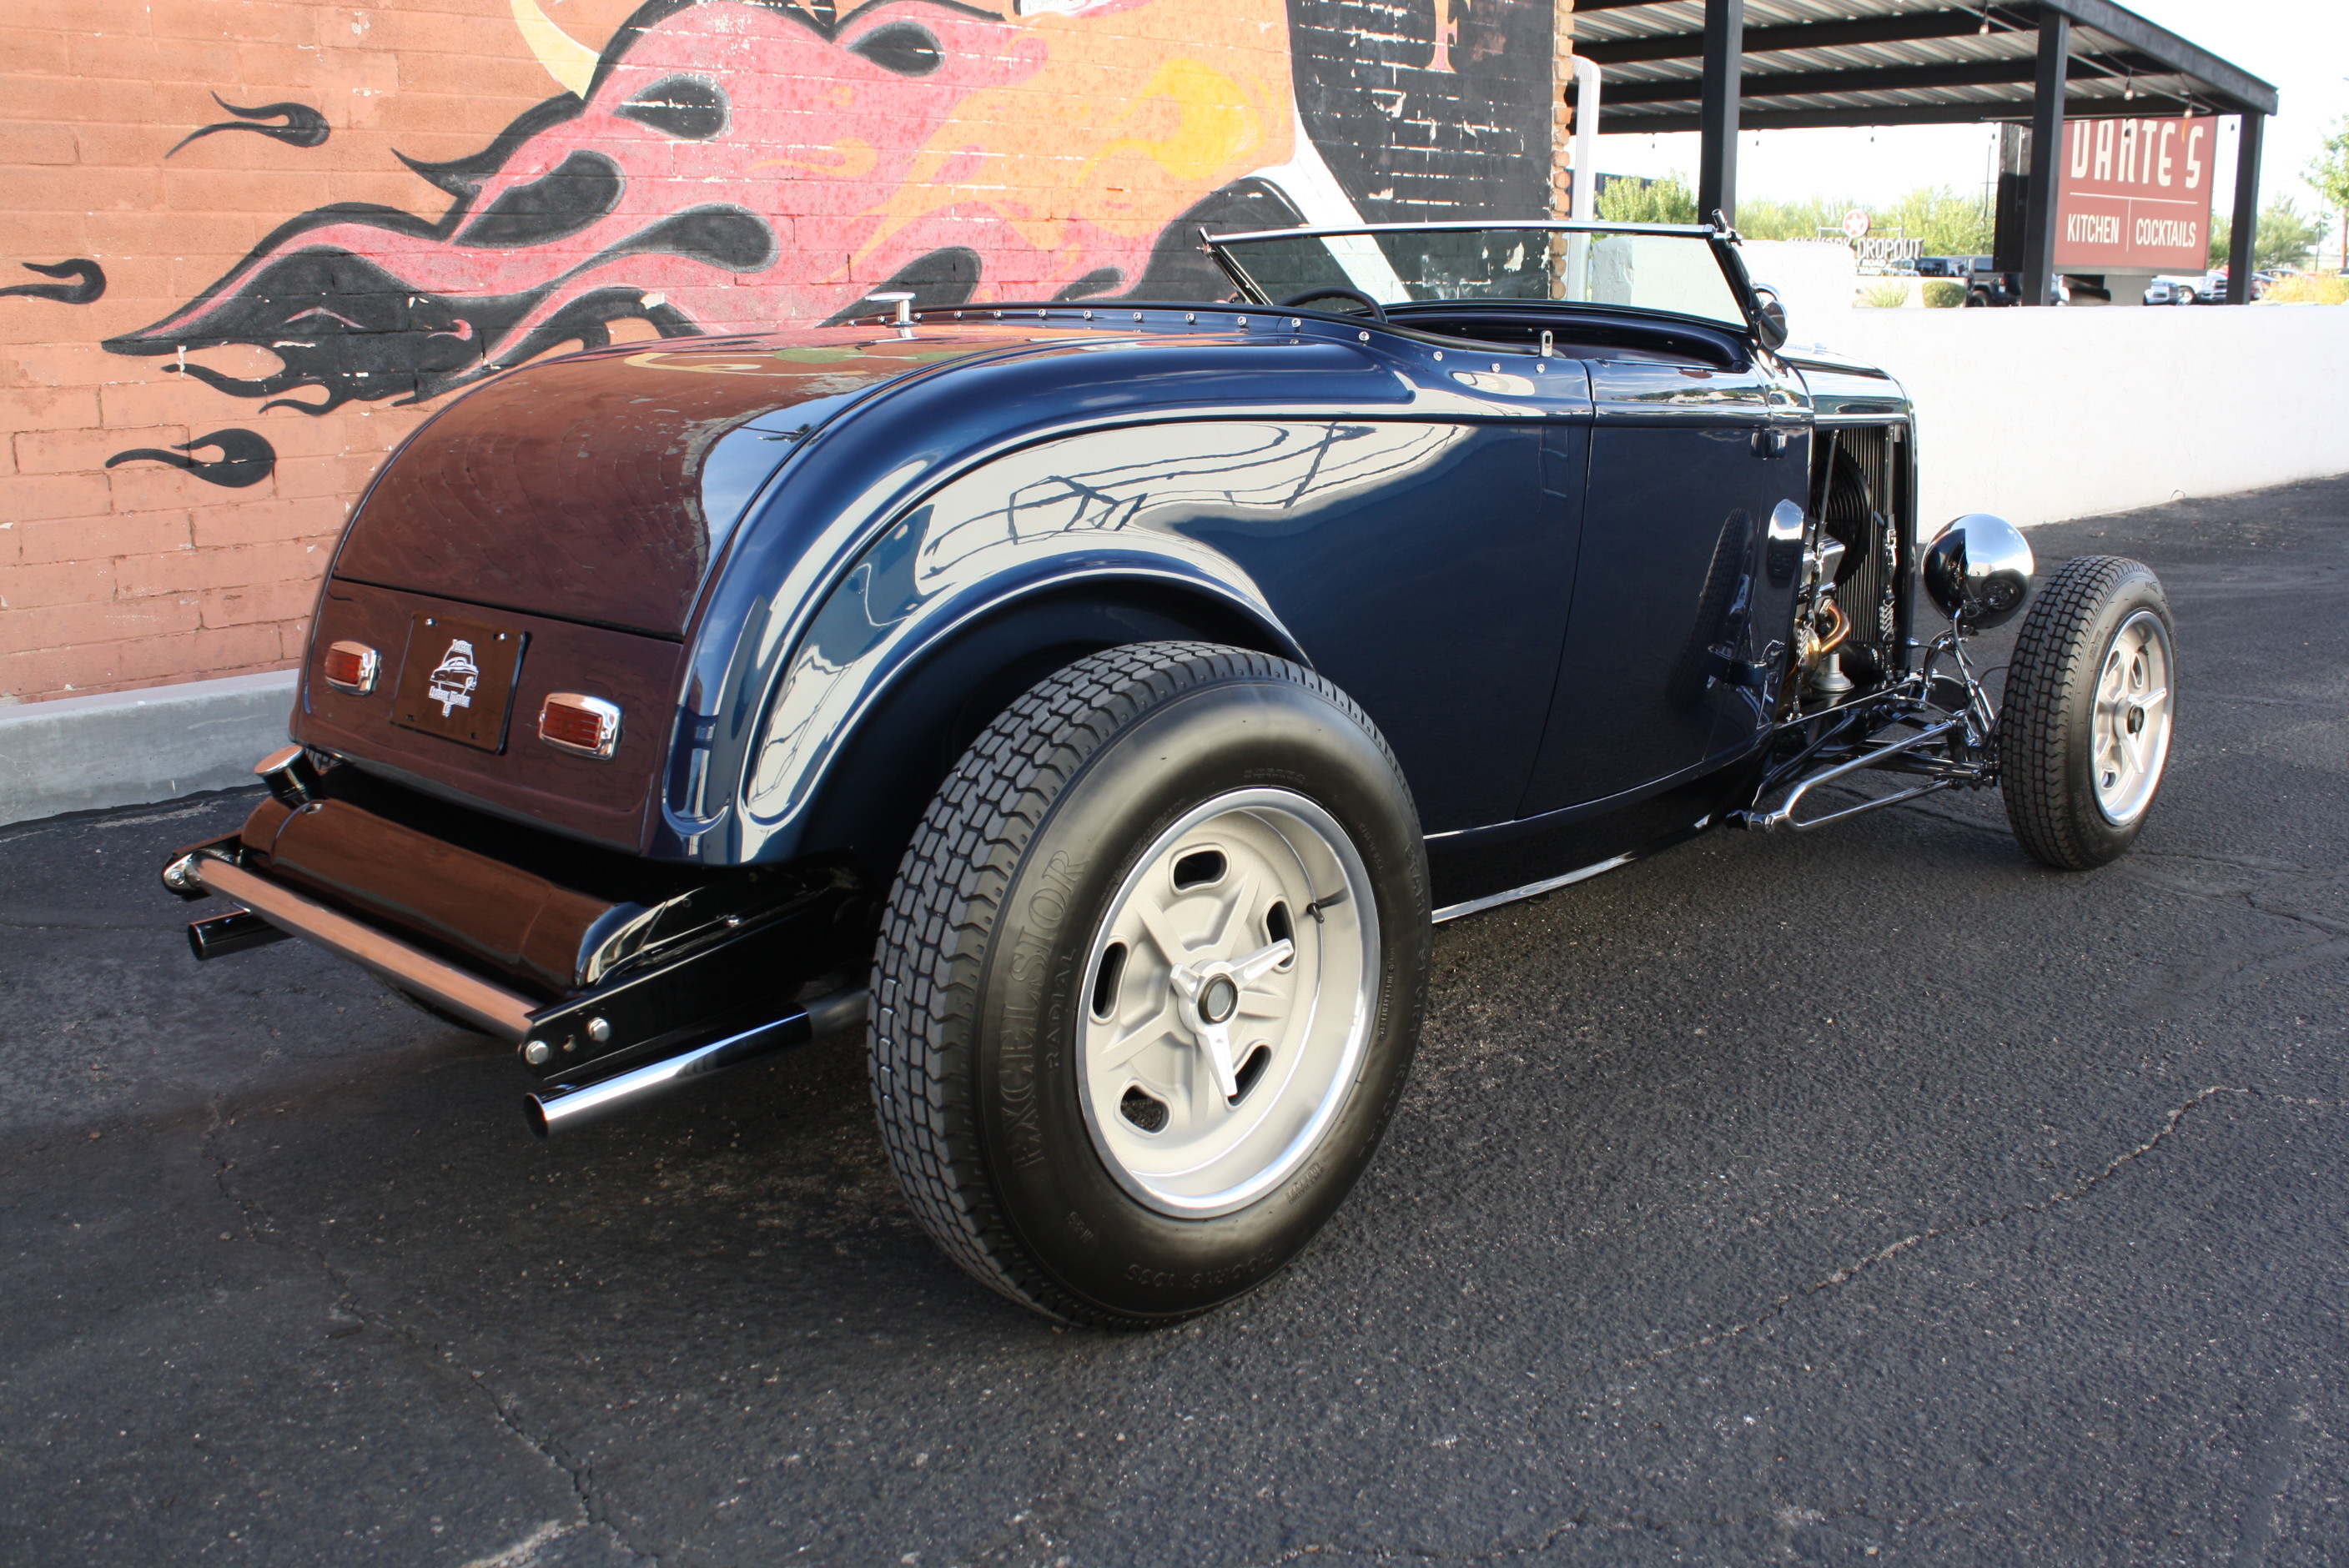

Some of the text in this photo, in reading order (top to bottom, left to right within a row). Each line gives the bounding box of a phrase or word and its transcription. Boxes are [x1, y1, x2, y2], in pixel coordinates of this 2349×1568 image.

[2070, 118, 2204, 188] DANTE'S
[1857, 238, 1923, 259] DROPOUT
[2067, 213, 2196, 248] KITCHEN COCKTAILS
[999, 850, 1090, 1168] EXCELSIOR
[1046, 947, 1077, 1072] RADIAL
